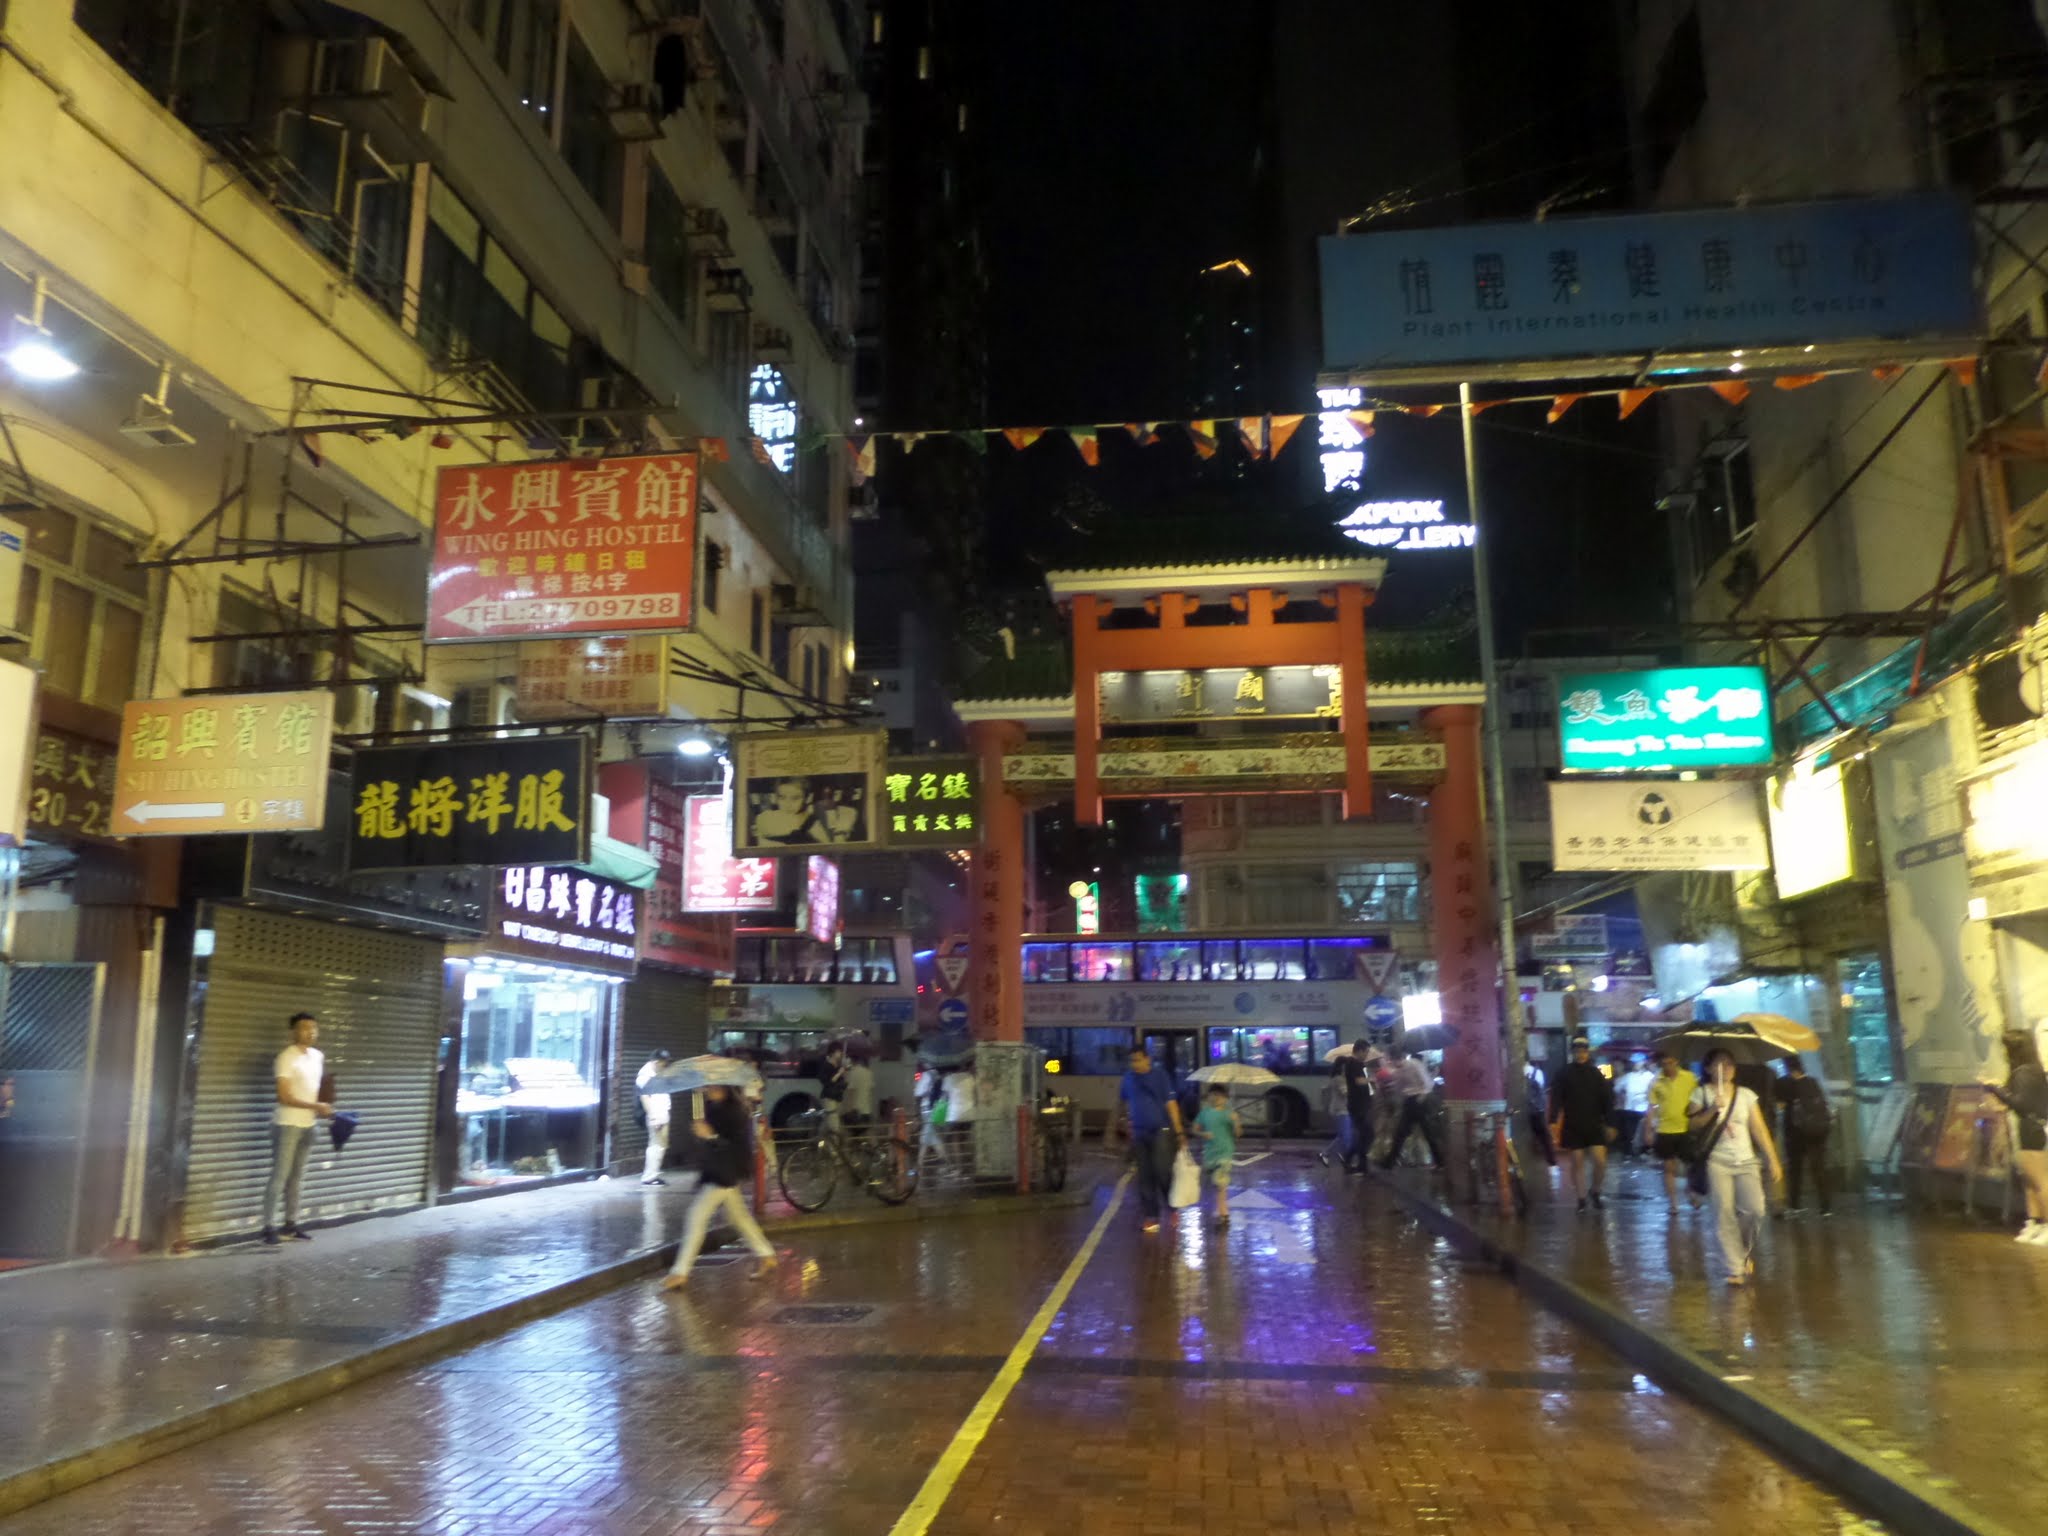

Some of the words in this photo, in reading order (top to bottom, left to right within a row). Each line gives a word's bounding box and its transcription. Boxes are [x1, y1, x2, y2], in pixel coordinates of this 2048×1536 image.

[1404, 319, 1474, 338] Plant
[1487, 307, 1668, 332] International
[1682, 299, 1774, 319] Health
[446, 460, 694, 531] 永興賓館
[443, 532, 510, 555] WING
[514, 528, 579, 550] HING
[585, 523, 686, 547] HOSTEL
[354, 768, 577, 840] 龍將洋服
